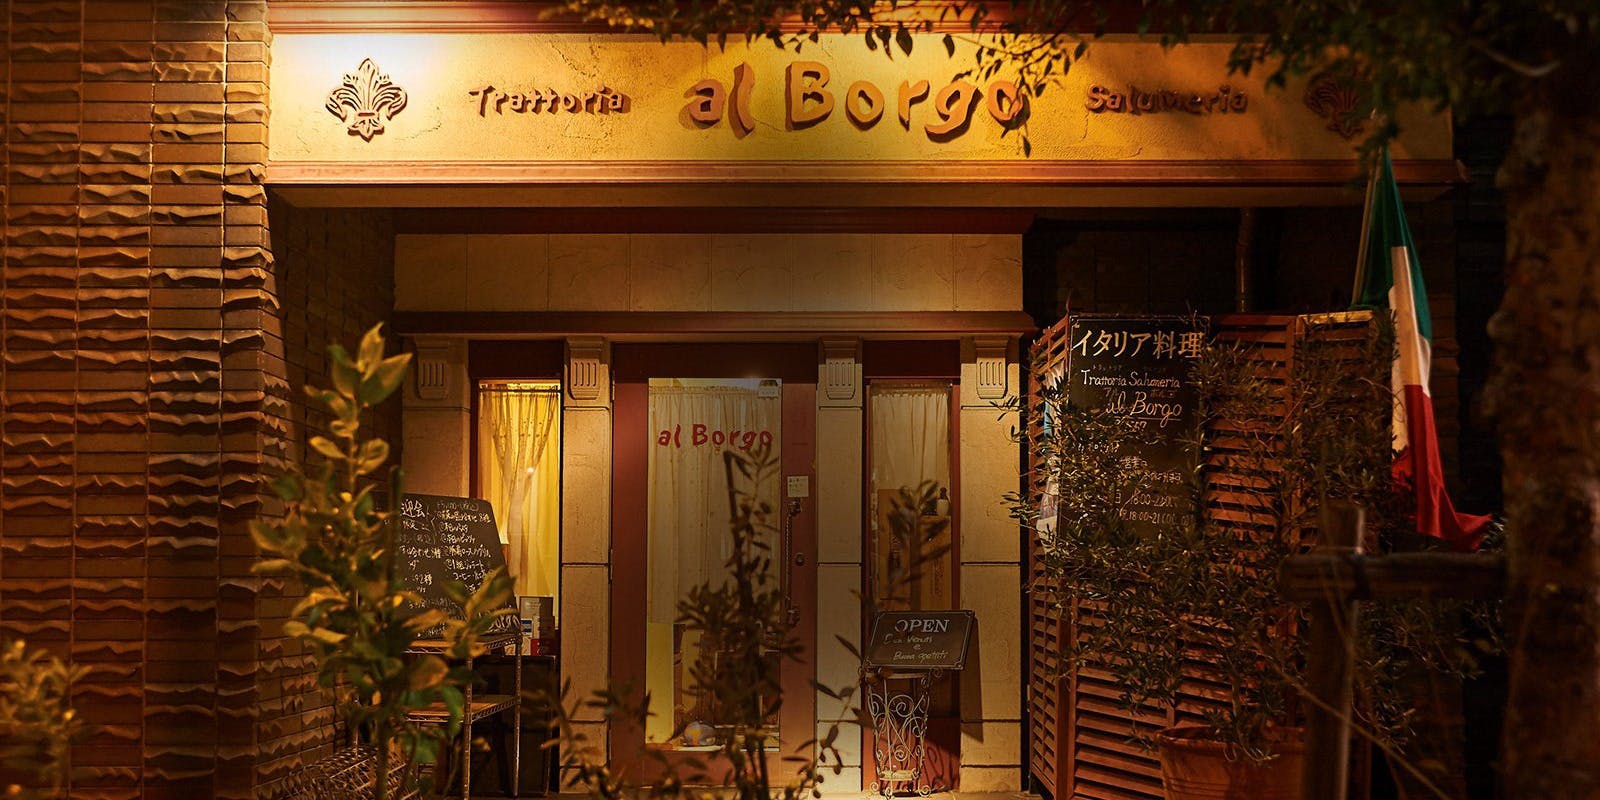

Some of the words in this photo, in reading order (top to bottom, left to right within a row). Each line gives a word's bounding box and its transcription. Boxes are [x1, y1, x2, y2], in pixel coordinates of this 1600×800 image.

[468, 85, 631, 117] Trattoria
[683, 61, 755, 138] al
[785, 60, 1030, 144] Borgo
[1084, 82, 1249, 116] Salumeria
[1071, 329, 1205, 360] イタリア料理
[1080, 369, 1128, 387] Trattoria
[1130, 390, 1183, 428] Borgo
[658, 424, 681, 449] al
[692, 424, 774, 450] Borgo
[894, 619, 950, 633] OPEN
